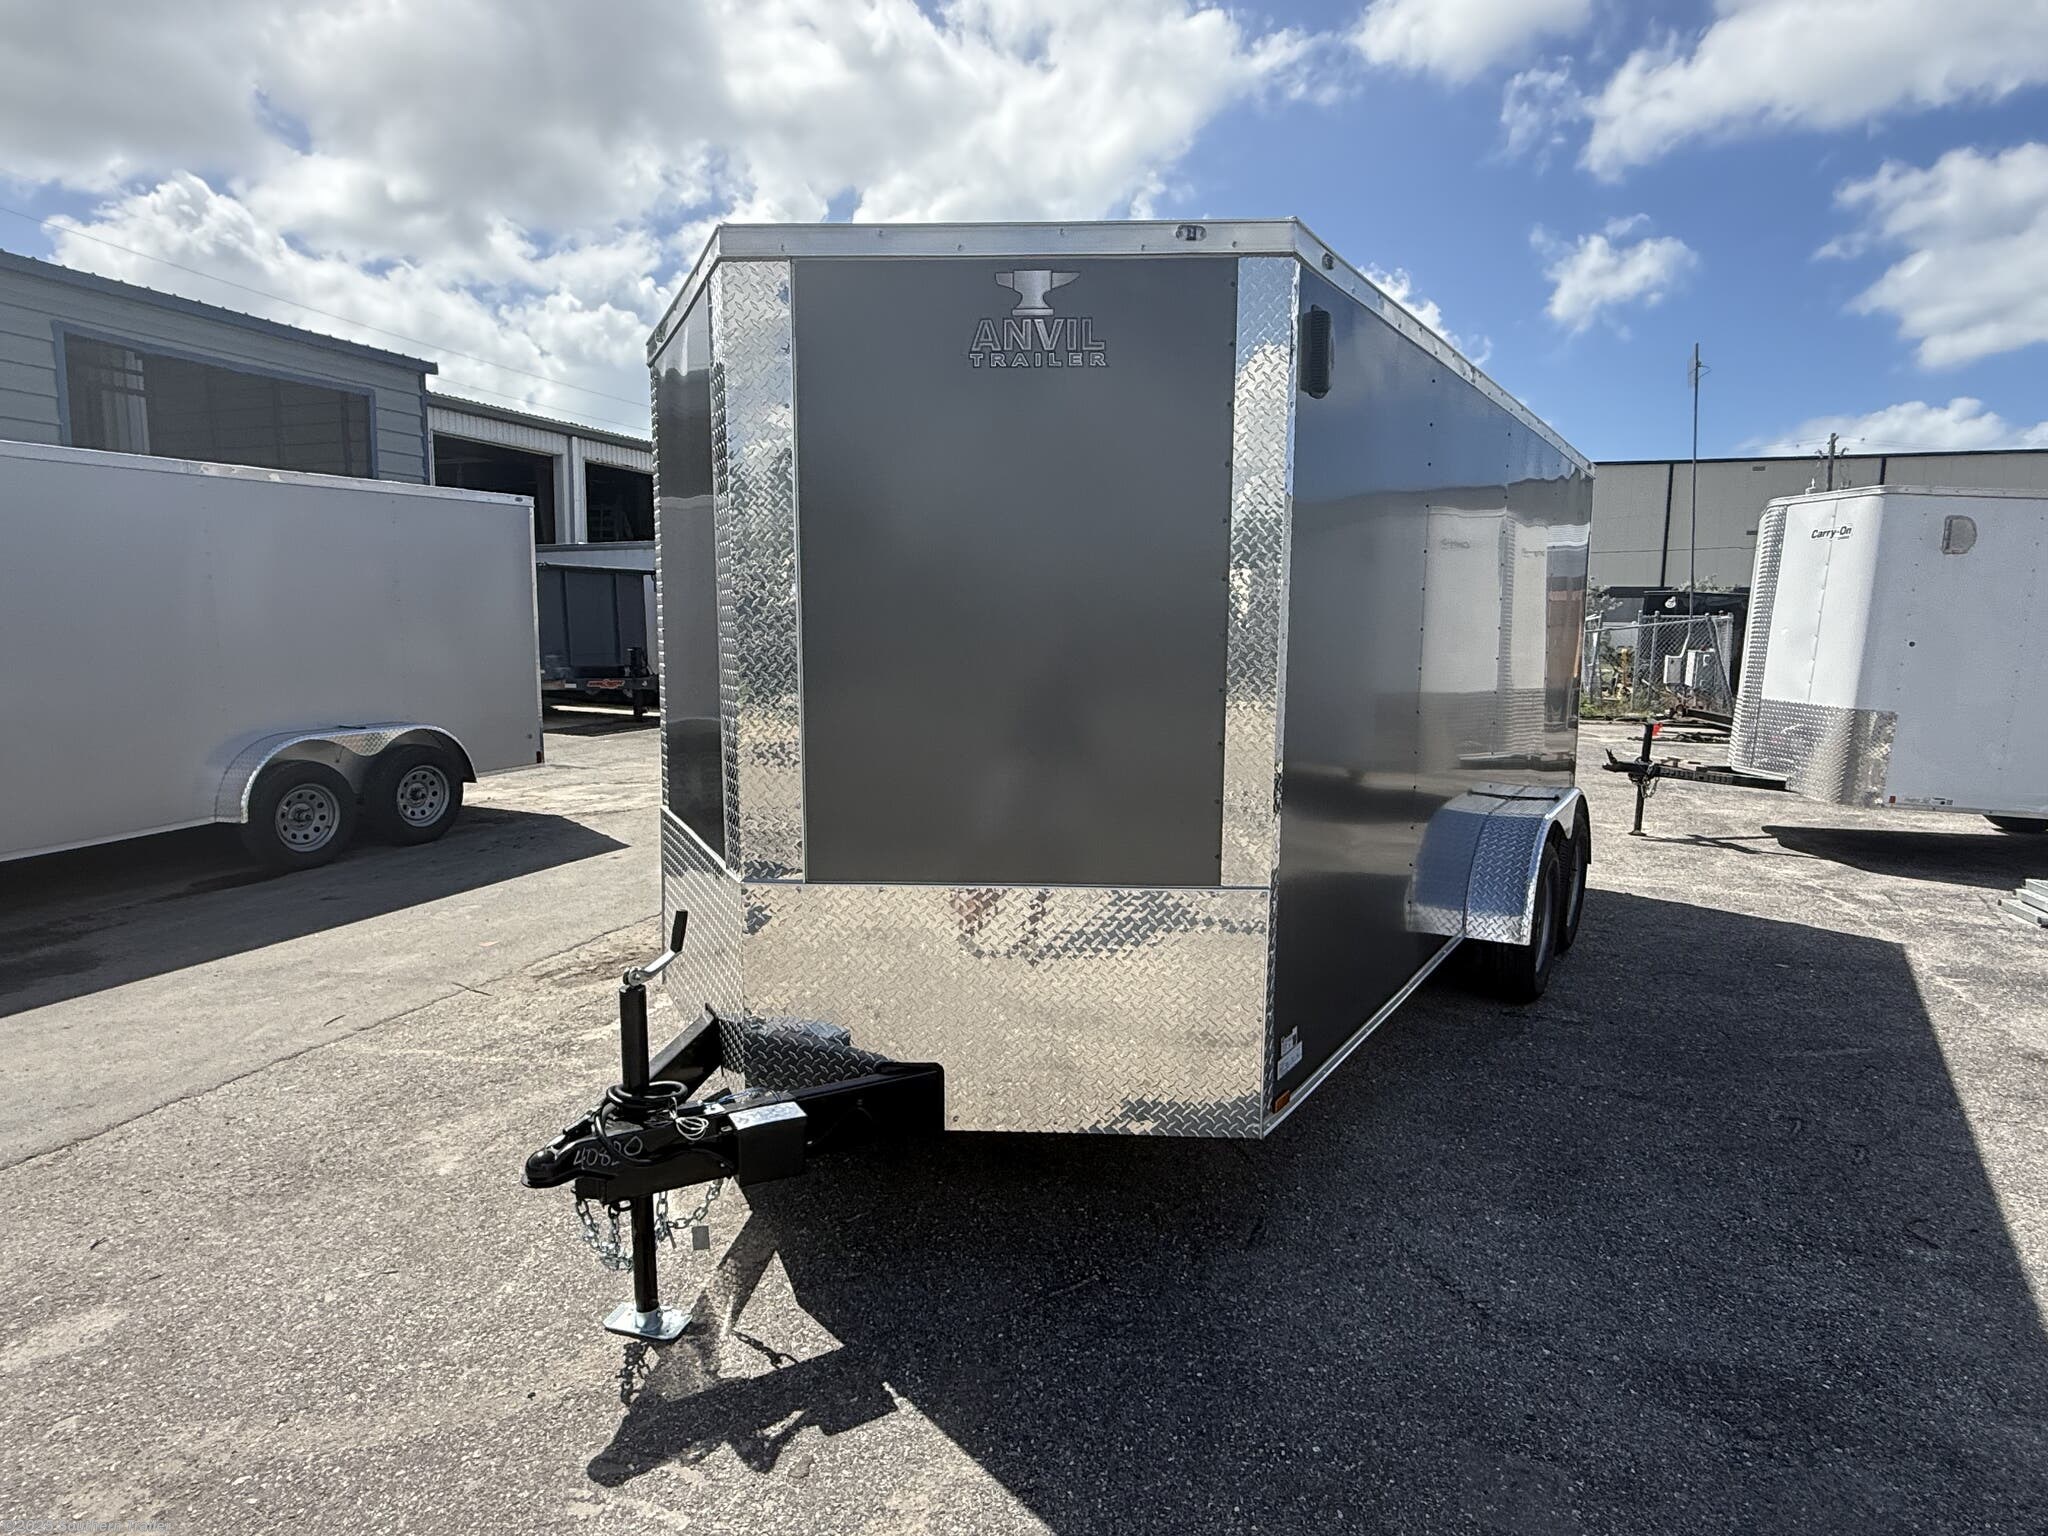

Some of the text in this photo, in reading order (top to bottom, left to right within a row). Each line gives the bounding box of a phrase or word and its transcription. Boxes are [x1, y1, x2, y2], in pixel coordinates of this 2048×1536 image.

[970, 317, 1106, 351] ANVIL
[969, 352, 1108, 368] TRAILER
[1811, 526, 1852, 539] Carry-On
